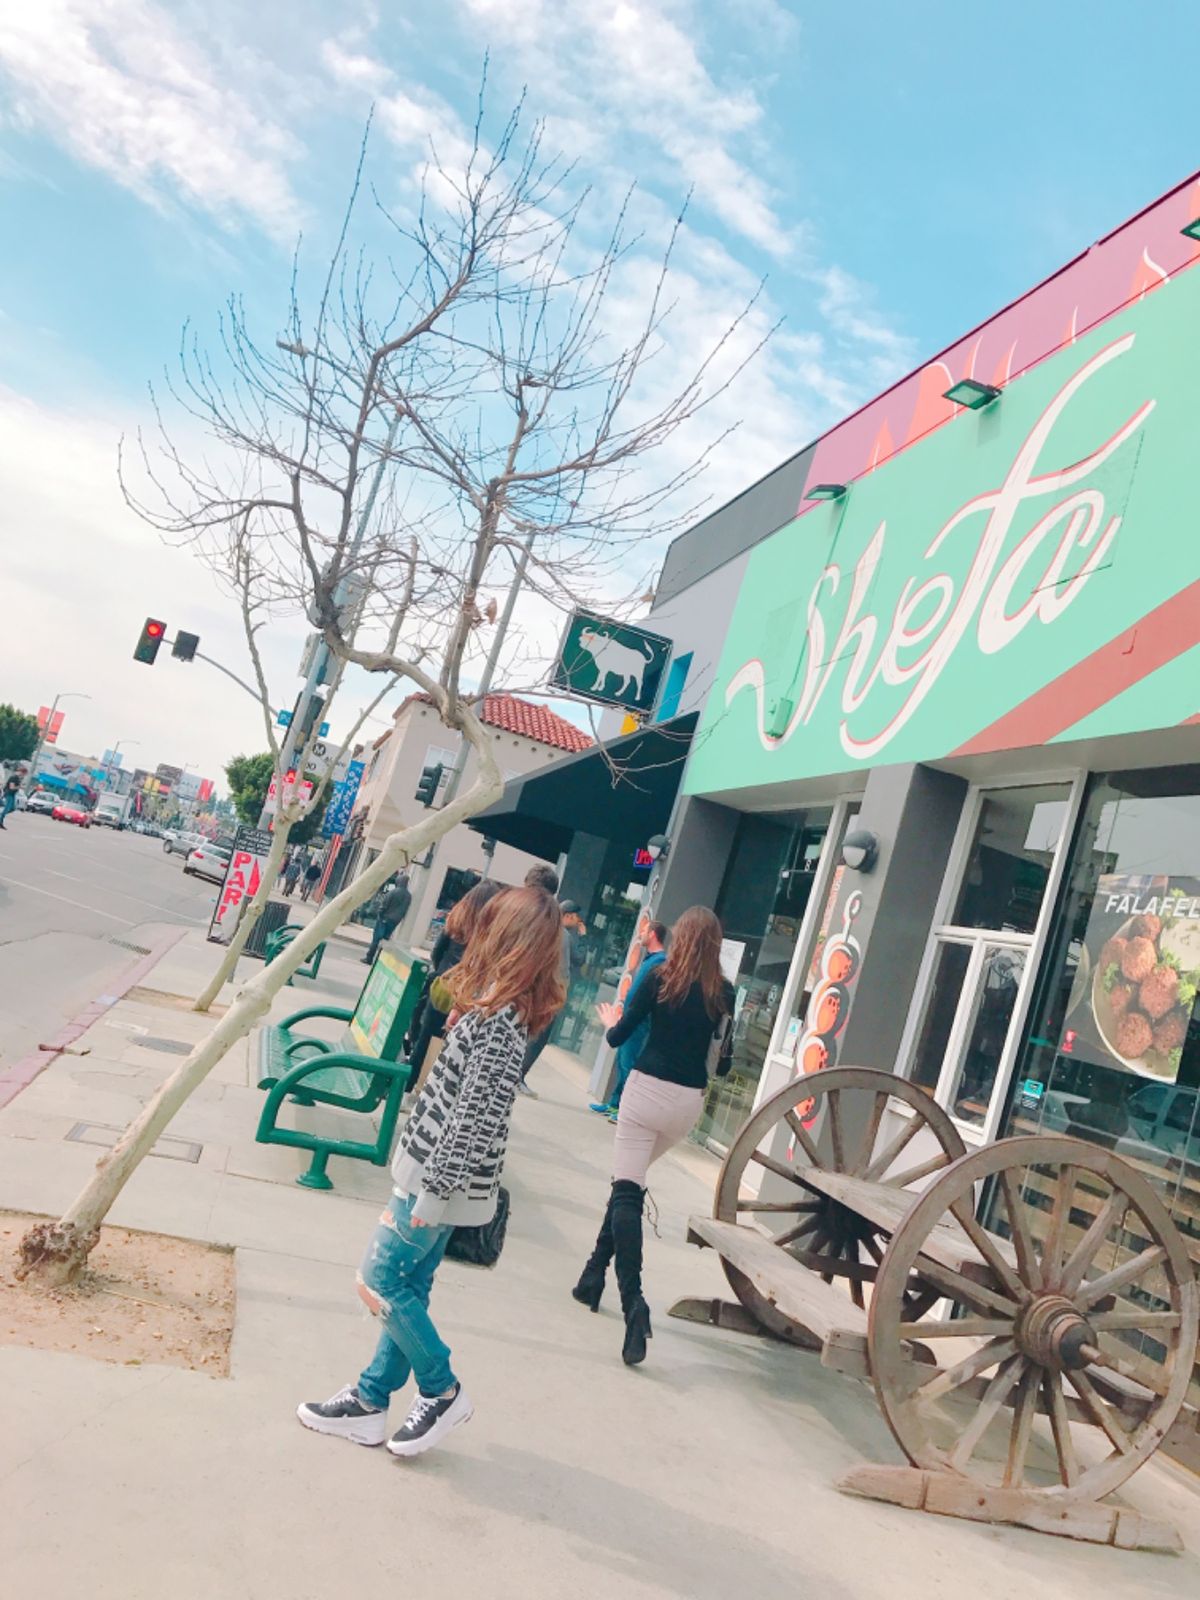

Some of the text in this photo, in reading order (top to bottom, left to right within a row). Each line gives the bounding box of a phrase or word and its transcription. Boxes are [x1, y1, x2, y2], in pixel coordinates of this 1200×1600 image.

[725, 332, 1157, 760] Shefa
[1104, 894, 1200, 918] FALAFEL
[449, 1123, 473, 1159] NIKE
